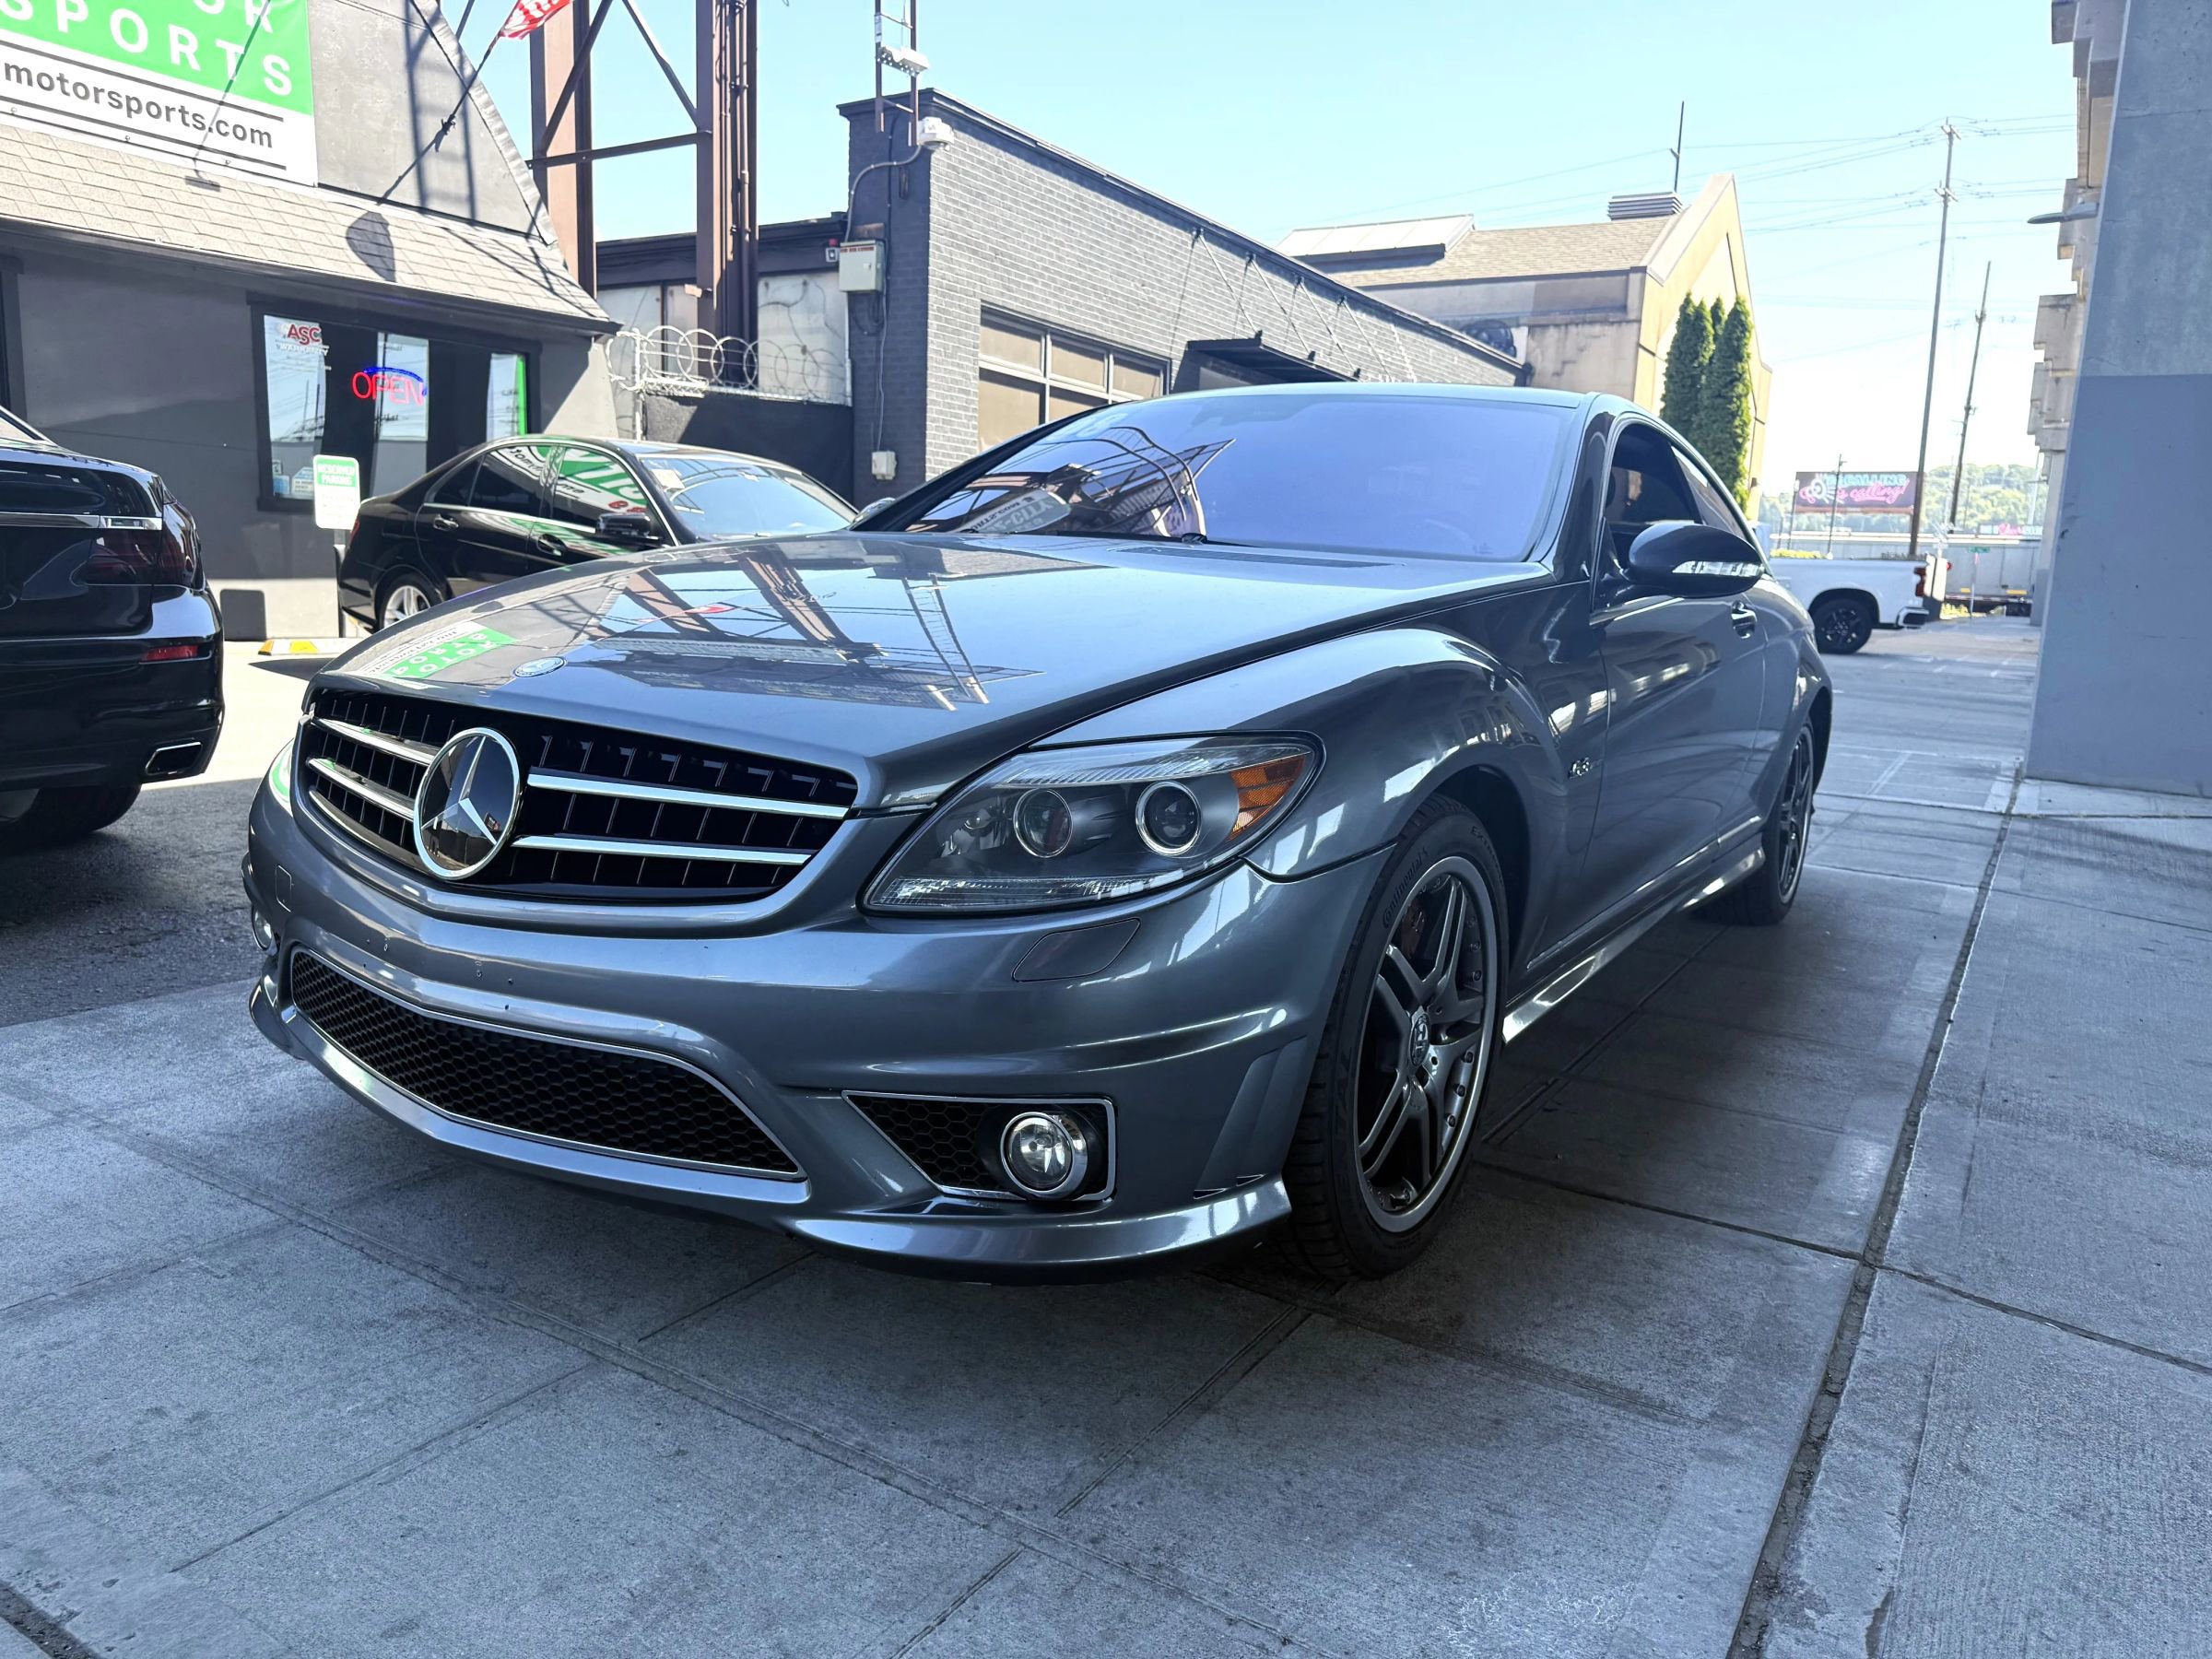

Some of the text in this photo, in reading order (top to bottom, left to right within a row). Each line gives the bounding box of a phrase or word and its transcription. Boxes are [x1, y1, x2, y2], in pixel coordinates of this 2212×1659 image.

[4, 61, 273, 148] motorsports.com
[287, 324, 322, 346] ASC
[352, 371, 425, 406] OPEN
